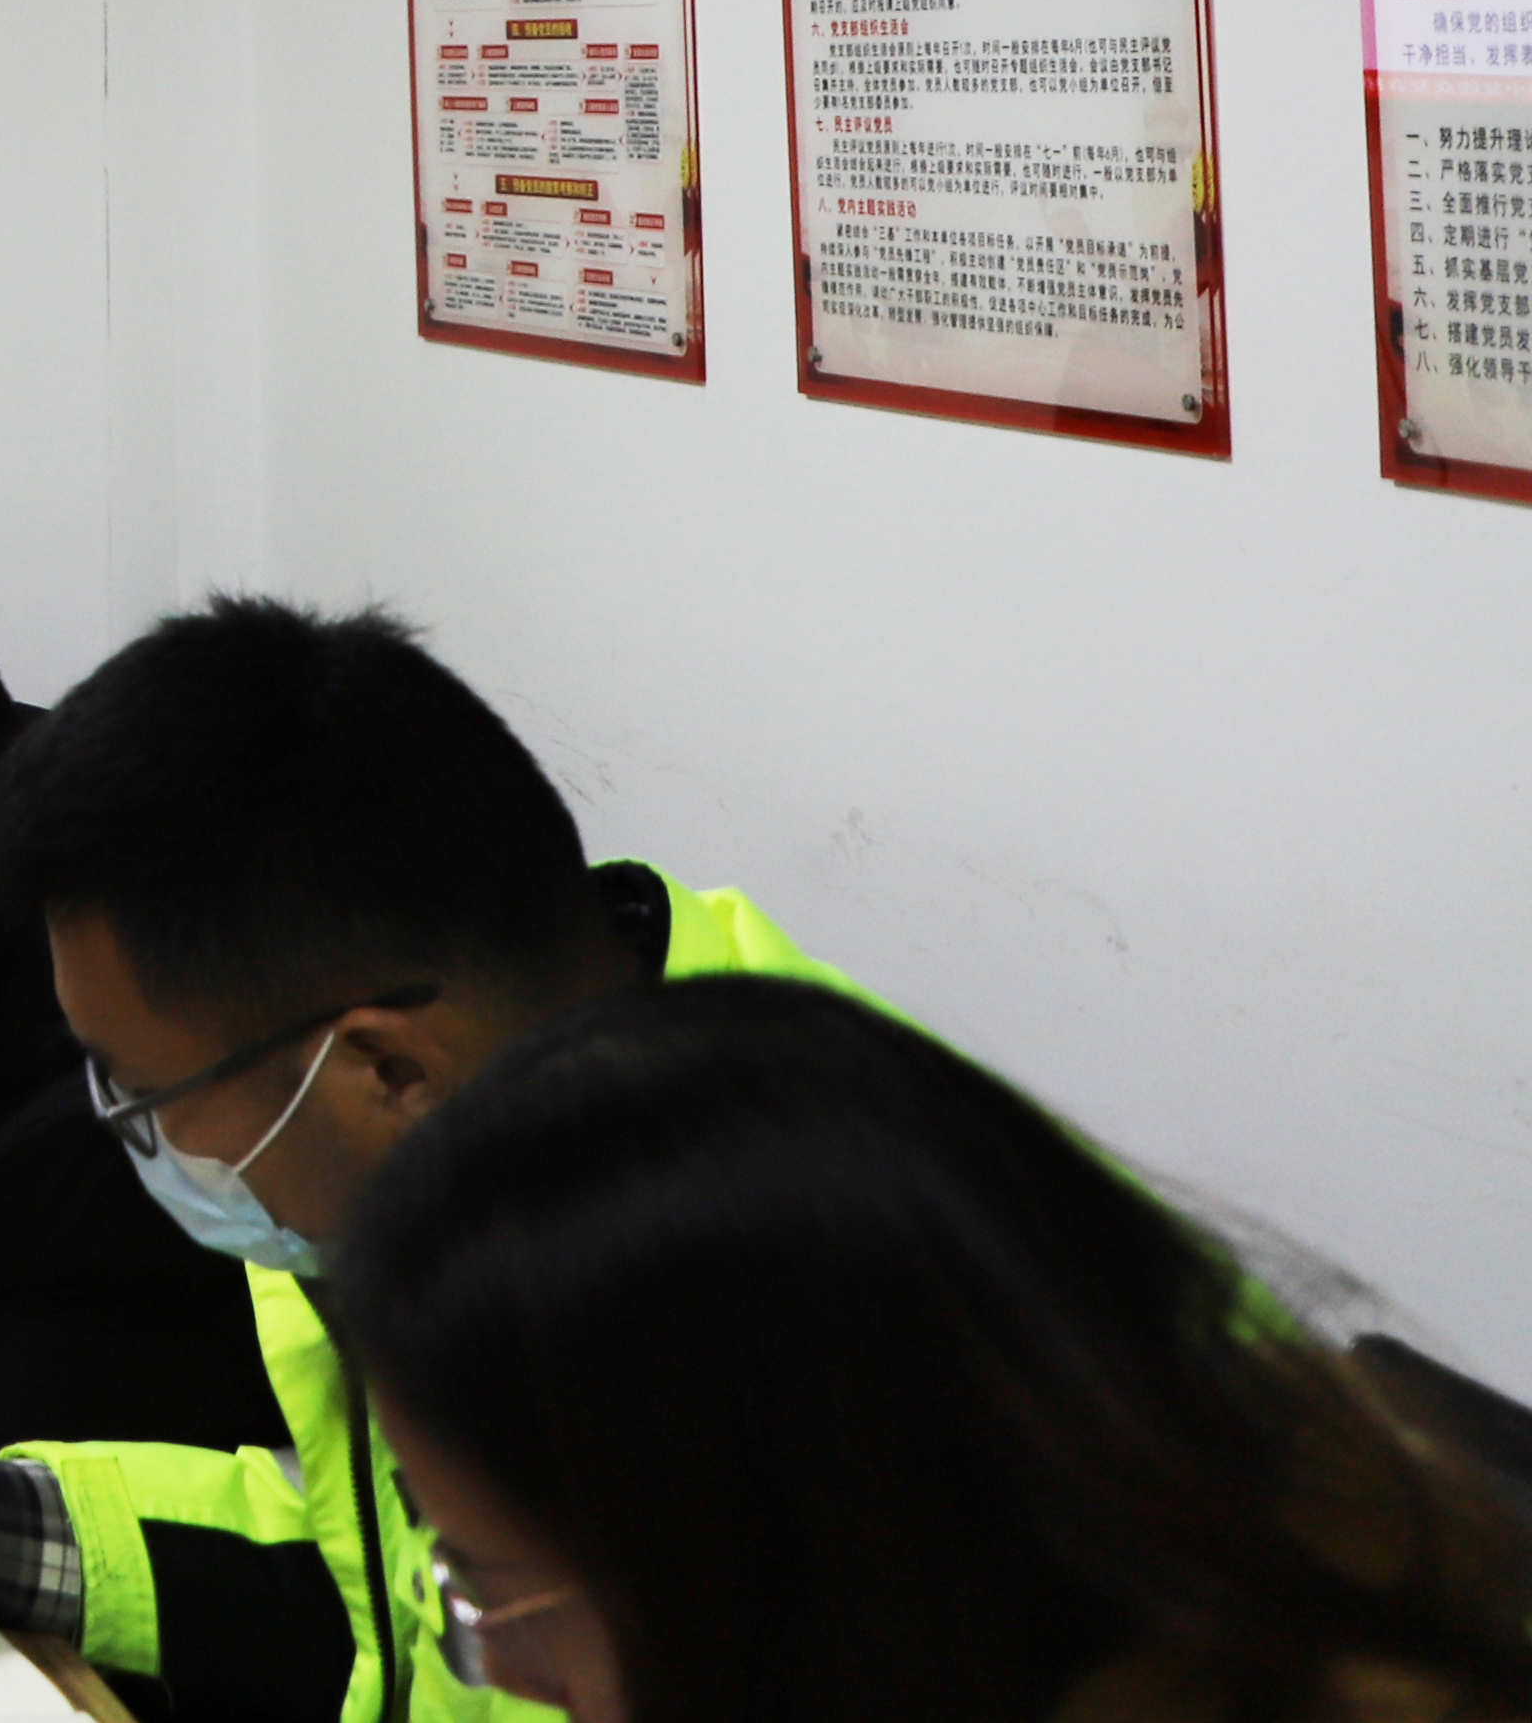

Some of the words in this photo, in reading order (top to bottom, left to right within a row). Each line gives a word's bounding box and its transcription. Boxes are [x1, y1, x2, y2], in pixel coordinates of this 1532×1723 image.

[1410, 220, 1532, 252] 四、定期进行“
